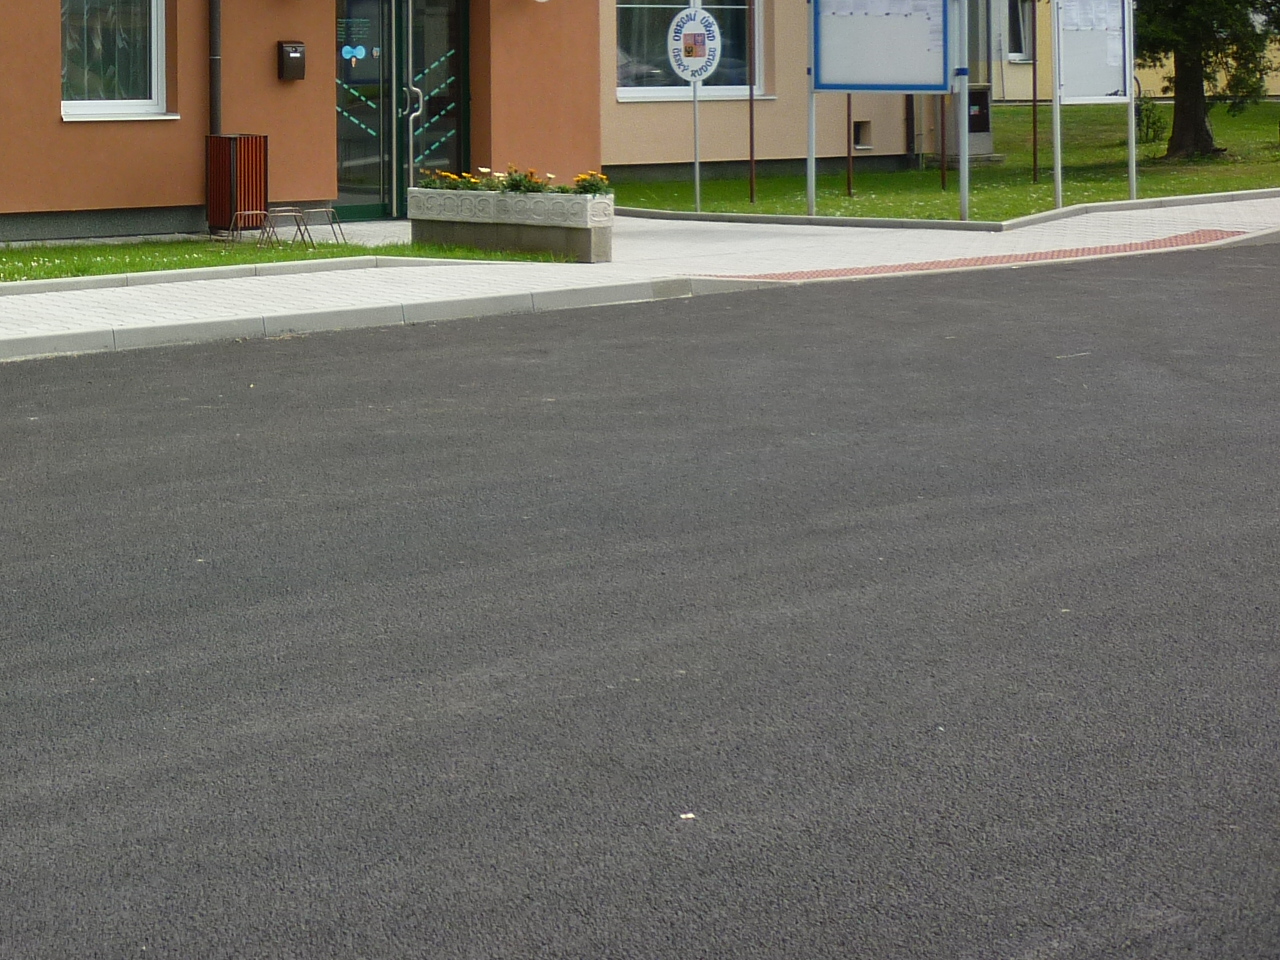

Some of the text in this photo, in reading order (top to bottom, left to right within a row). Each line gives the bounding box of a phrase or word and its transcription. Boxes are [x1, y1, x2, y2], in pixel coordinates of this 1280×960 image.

[673, 10, 715, 41] OBECNÍ ÚŘAD
[672, 47, 716, 77] ČESKÝ RUDOLEC
